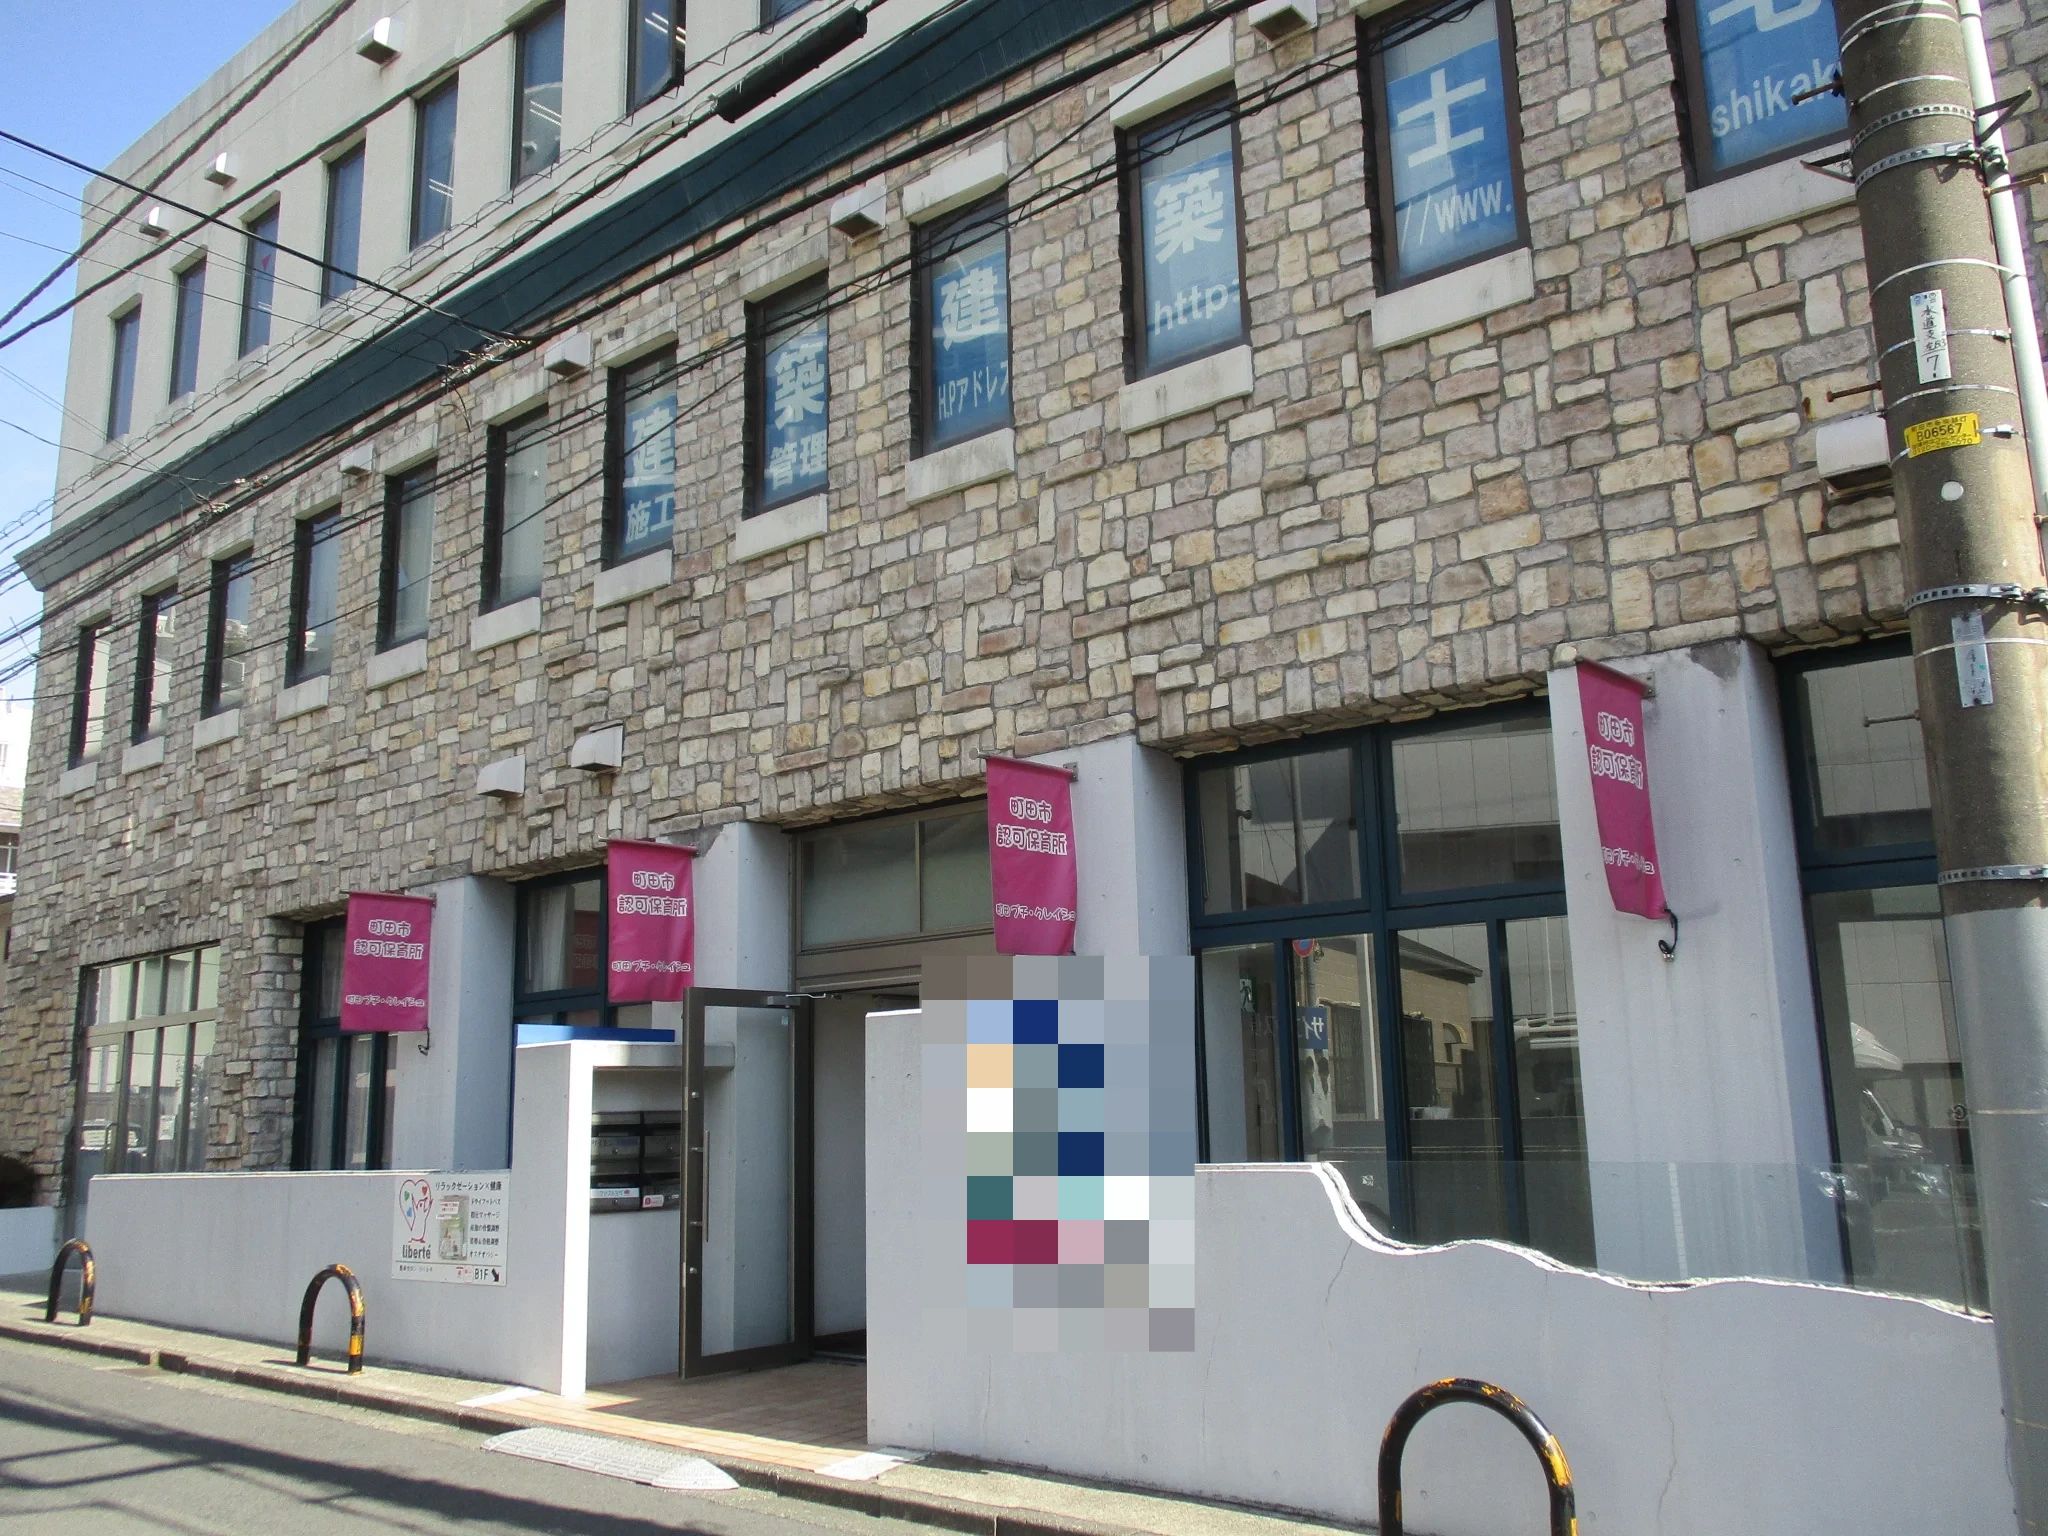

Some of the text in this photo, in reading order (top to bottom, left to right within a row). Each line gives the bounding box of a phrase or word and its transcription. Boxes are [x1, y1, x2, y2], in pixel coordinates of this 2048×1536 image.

[1397, 68, 1487, 168] 士
[1153, 166, 1225, 264] 築
[1402, 180, 1512, 252] //www.
[939, 267, 1002, 351] 建
[775, 342, 825, 431] 築
[632, 407, 675, 485] 建
[1917, 423, 1962, 441] B06567
[770, 430, 827, 491] 管理
[626, 492, 674, 544] 施工
[1598, 711, 1634, 747] 町田市
[1009, 797, 1052, 823] 町田市
[996, 825, 1067, 855] 認可保育所
[633, 871, 675, 891] 町田市
[617, 894, 687, 917] 認可保育所
[369, 919, 411, 937] 町田市
[354, 939, 424, 960] 認可保育所
[402, 1243, 431, 1259] liberté
[475, 1268, 488, 1280] B1F
